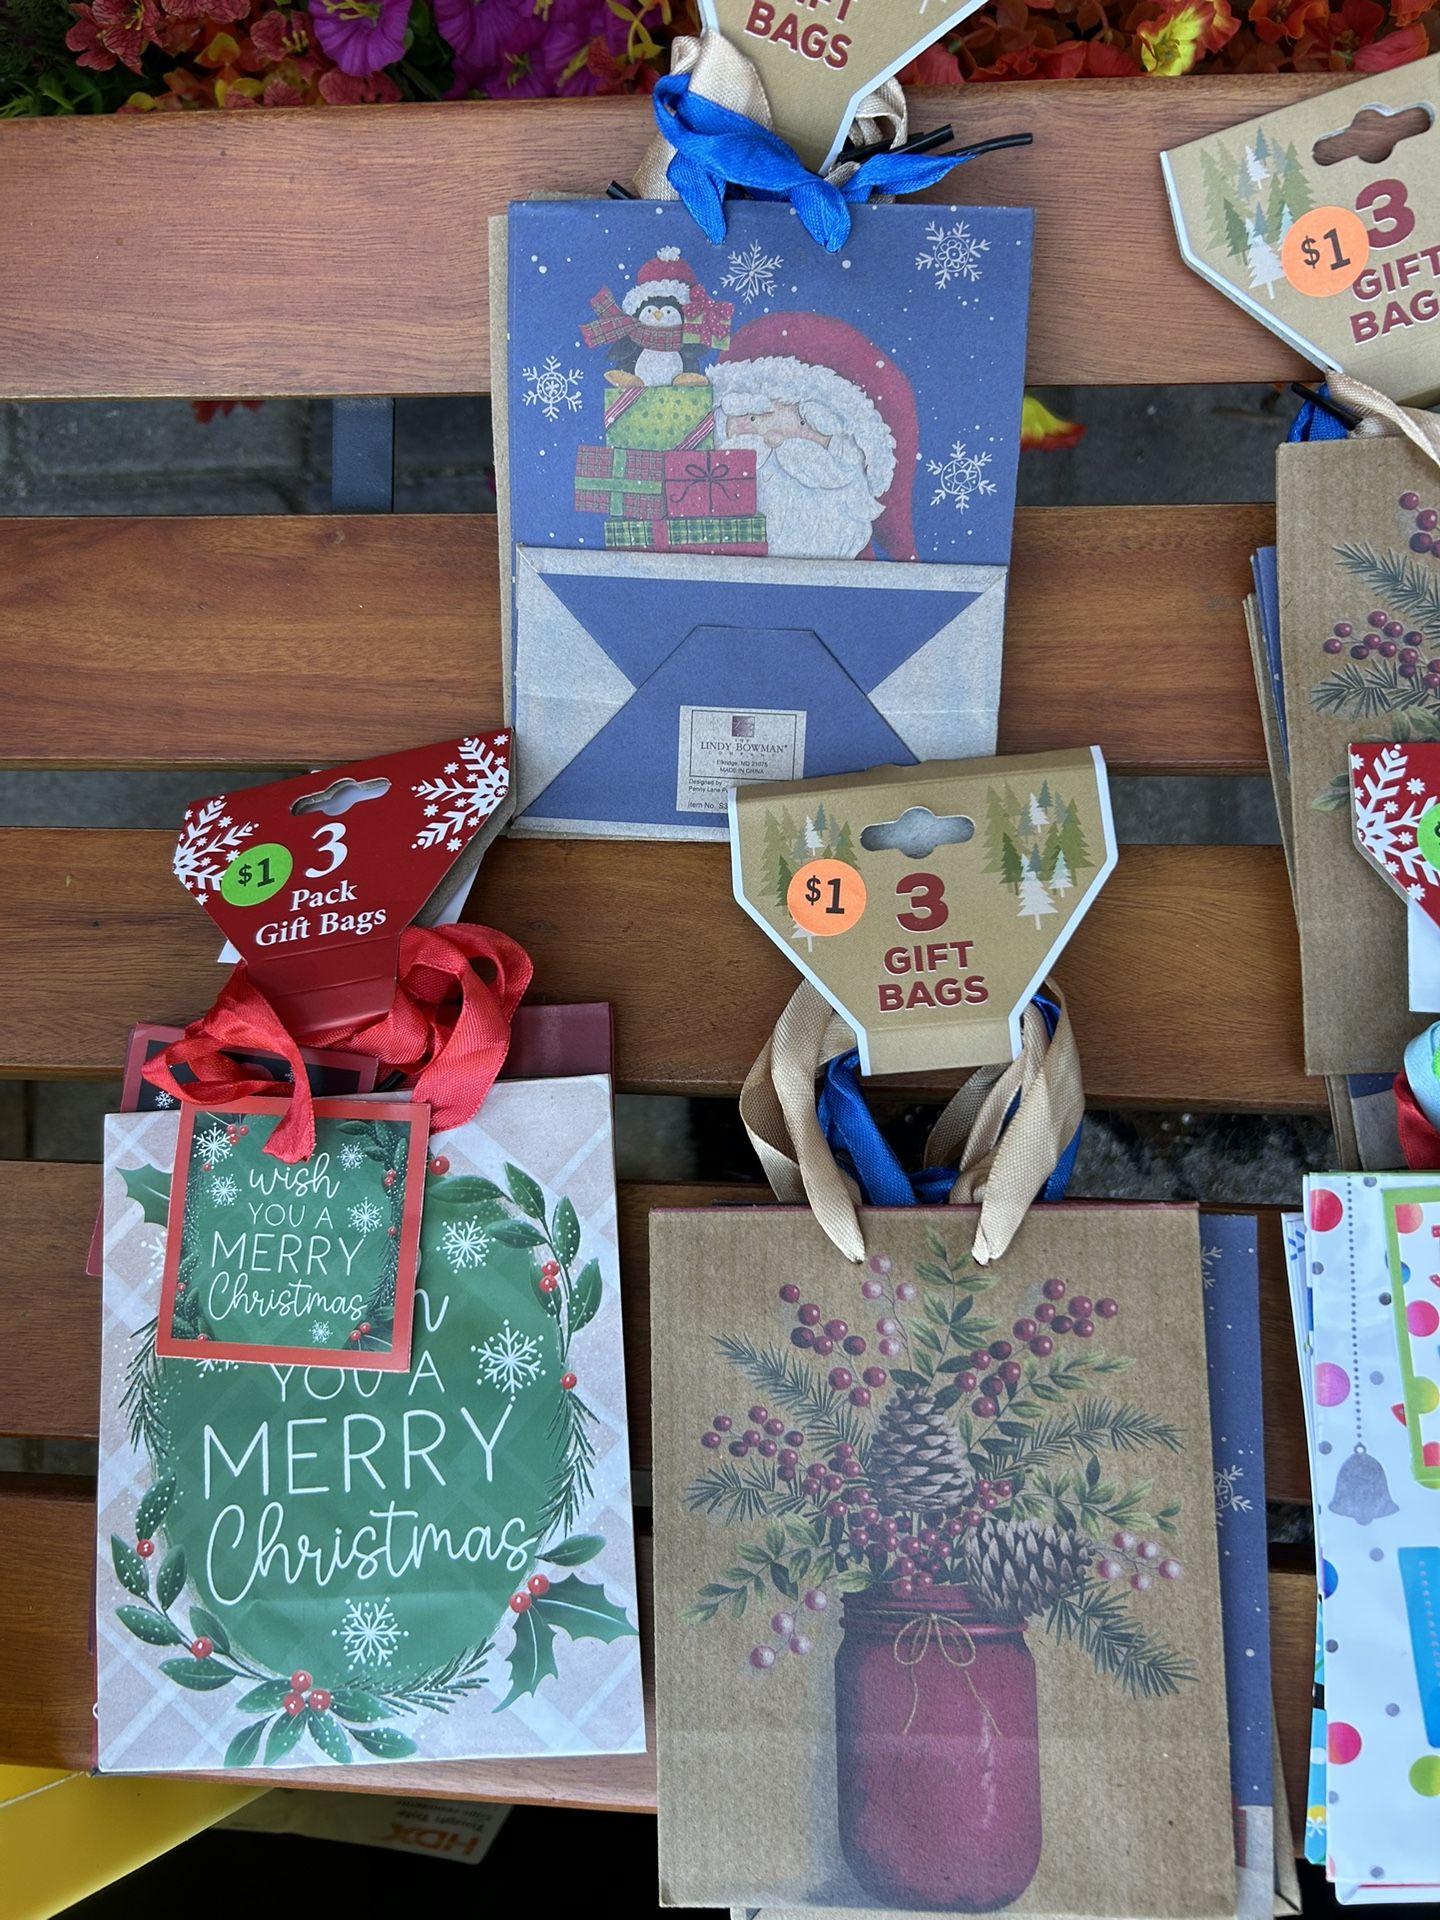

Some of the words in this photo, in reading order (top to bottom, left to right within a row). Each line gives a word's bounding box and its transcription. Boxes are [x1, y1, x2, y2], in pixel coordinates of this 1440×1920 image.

[744, 0, 853, 69] BAGS
[1355, 178, 1415, 251] 3
[1300, 228, 1351, 271] $1
[1352, 244, 1440, 302] GIFT
[700, 741, 732, 751] LINDY
[688, 800, 703, 809] Item
[305, 822, 349, 878] 3
[237, 857, 276, 888] $1
[804, 874, 845, 915] $1
[289, 880, 358, 912] Pack
[895, 872, 950, 933] 3
[255, 918, 311, 947] Gift
[318, 907, 387, 937] Bags
[883, 940, 974, 976] GIFT
[877, 975, 989, 1014] BAGS
[250, 1152, 340, 1198] wish
[249, 1202, 306, 1227] YOU
[314, 1206, 334, 1230] A
[211, 1230, 365, 1276] MERRY
[208, 1271, 368, 1321] Christmas
[270, 1363, 382, 1402] YOU
[408, 1350, 445, 1396] A
[204, 1403, 514, 1500] MERRY
[206, 1500, 538, 1606] Christmas
[383, 1823, 481, 1856] HDX
